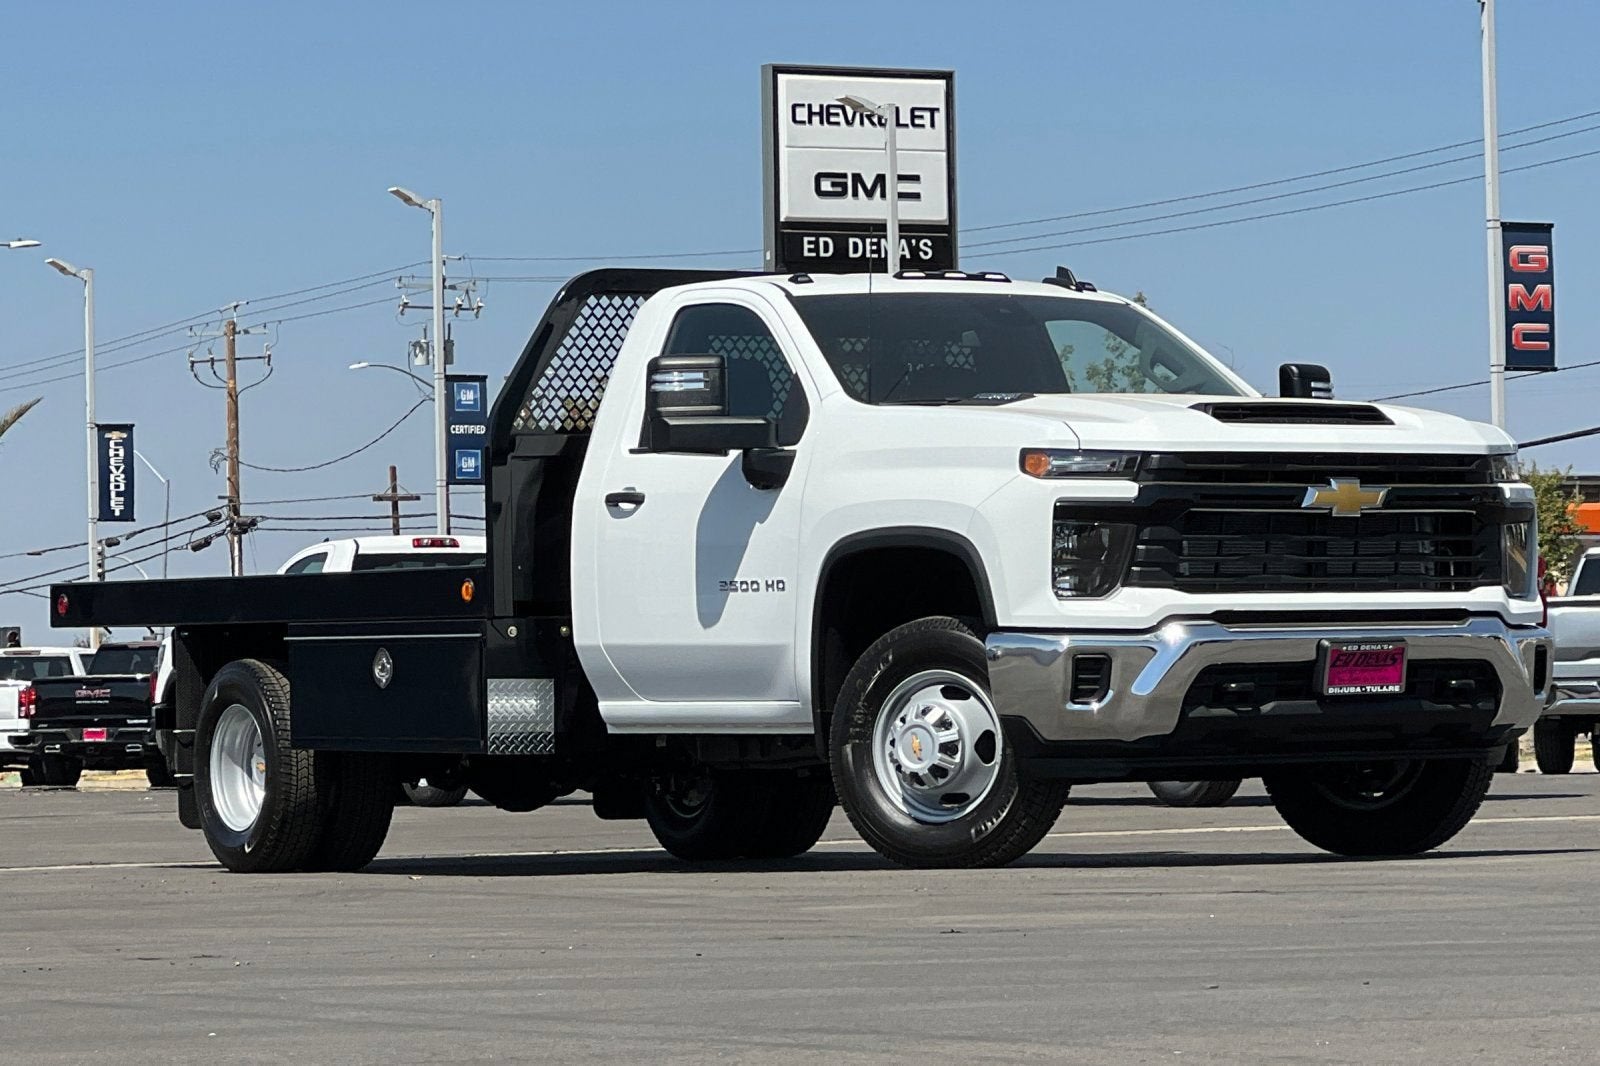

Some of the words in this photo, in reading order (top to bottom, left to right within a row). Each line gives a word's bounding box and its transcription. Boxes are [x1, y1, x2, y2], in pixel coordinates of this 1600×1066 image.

[803, 236, 834, 257] ED
[1508, 244, 1552, 350] GMC
[460, 389, 474, 400] GM
[450, 424, 486, 434] CERTIFIED
[461, 457, 475, 468] GM
[109, 439, 126, 516] CHEVROLET
[719, 581, 760, 592] 3500
[765, 580, 785, 592] HD
[75, 689, 111, 698] GMC
